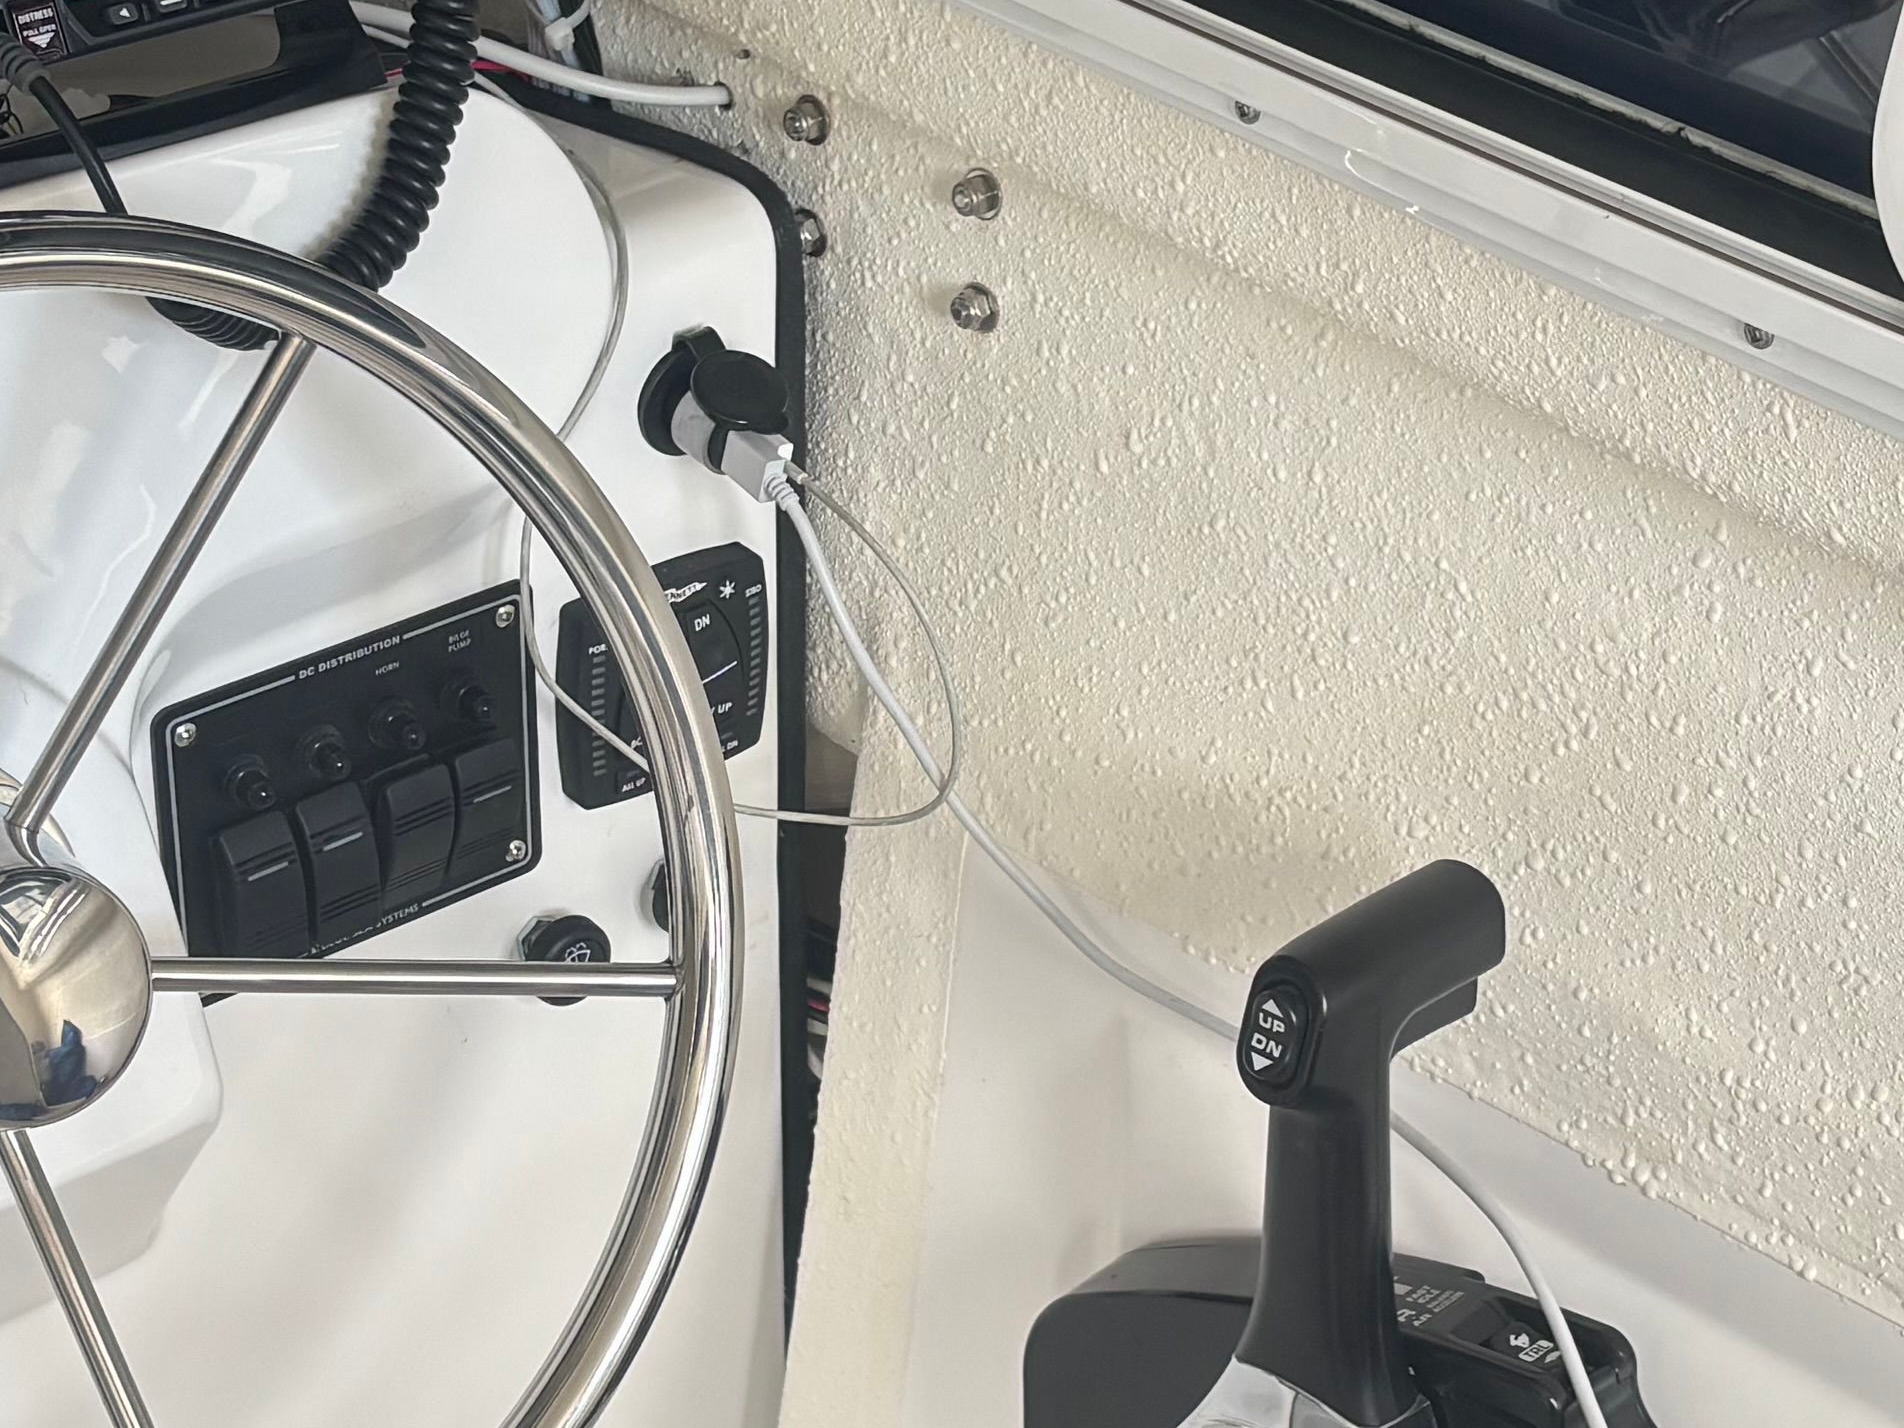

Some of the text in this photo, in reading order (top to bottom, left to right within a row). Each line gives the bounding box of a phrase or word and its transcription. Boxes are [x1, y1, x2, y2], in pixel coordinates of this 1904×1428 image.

[17, 8, 53, 24] DISTRESS
[694, 614, 711, 631] DN
[298, 635, 400, 679] DC DISTRIBUTION
[375, 661, 400, 676] HORN
[717, 702, 734, 715] UP
[376, 903, 419, 928] YSTEMS
[1259, 1012, 1285, 1033] UP
[1251, 1032, 1282, 1058] DN
